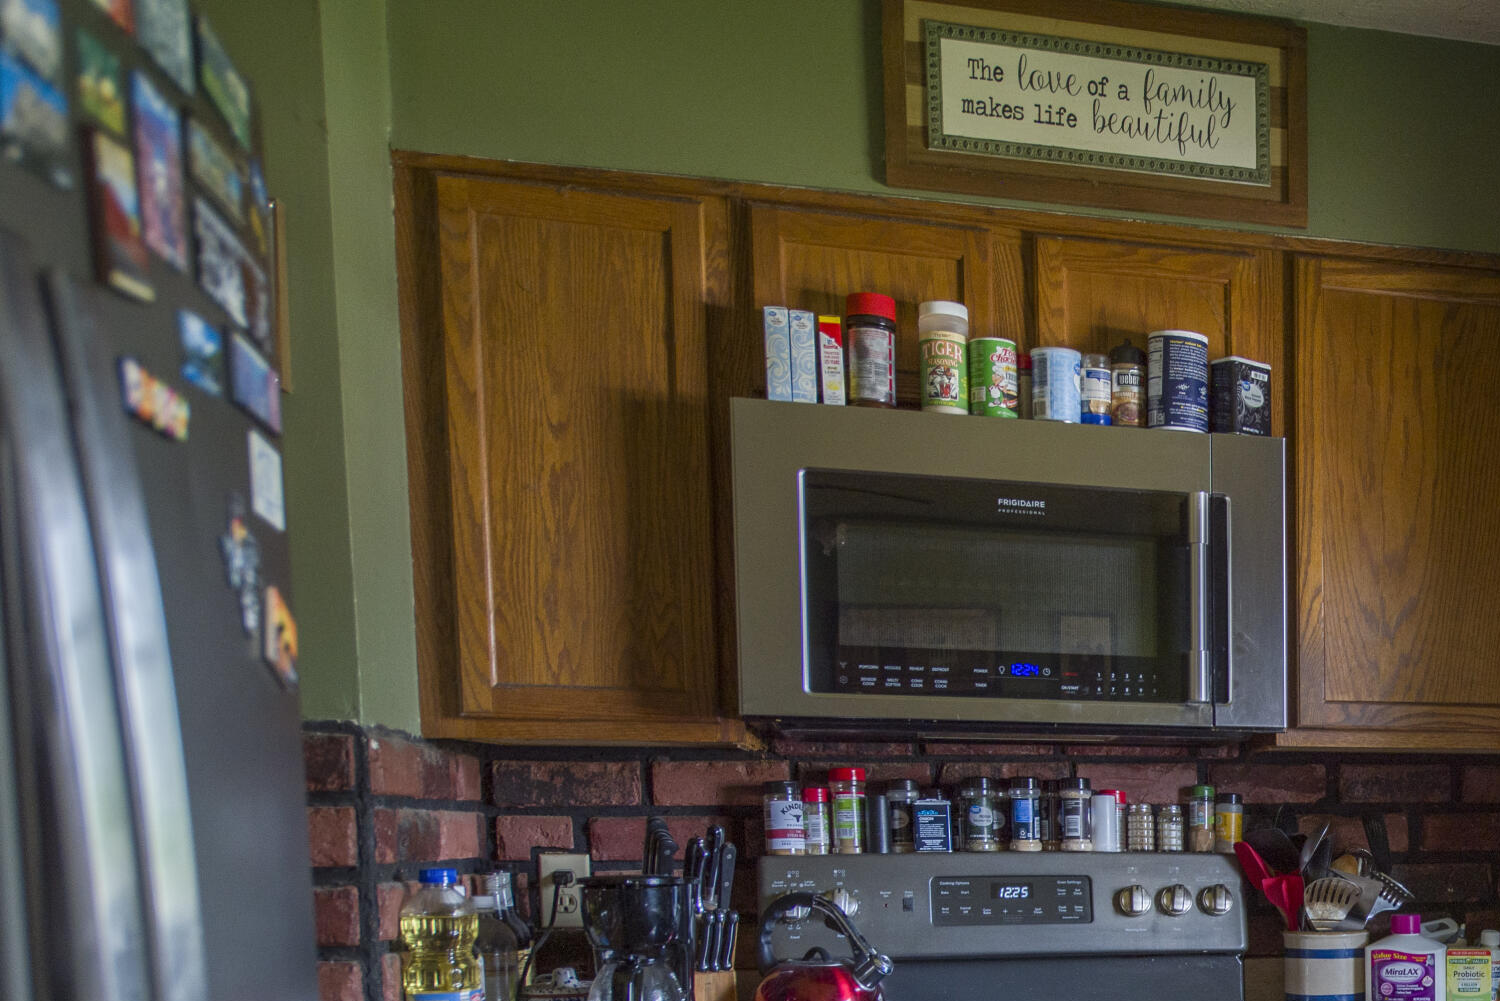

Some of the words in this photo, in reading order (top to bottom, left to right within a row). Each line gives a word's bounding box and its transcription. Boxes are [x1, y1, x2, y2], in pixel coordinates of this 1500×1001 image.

[968, 57, 1004, 83] The
[1017, 53, 1082, 97] love
[1087, 77, 1110, 98] of
[1117, 84, 1131, 101] a
[1143, 68, 1237, 129] family
[961, 96, 1026, 121] makes
[1033, 103, 1078, 129] life
[1092, 98, 1220, 156] beautiful
[922, 340, 963, 364] TIGER
[928, 358, 959, 369] SEASONING
[998, 498, 1046, 508] FRIGIDAIRE
[1372, 952, 1391, 960] Value
[1385, 967, 1419, 977] MiraLAX
[1453, 970, 1486, 978] Probiotic
